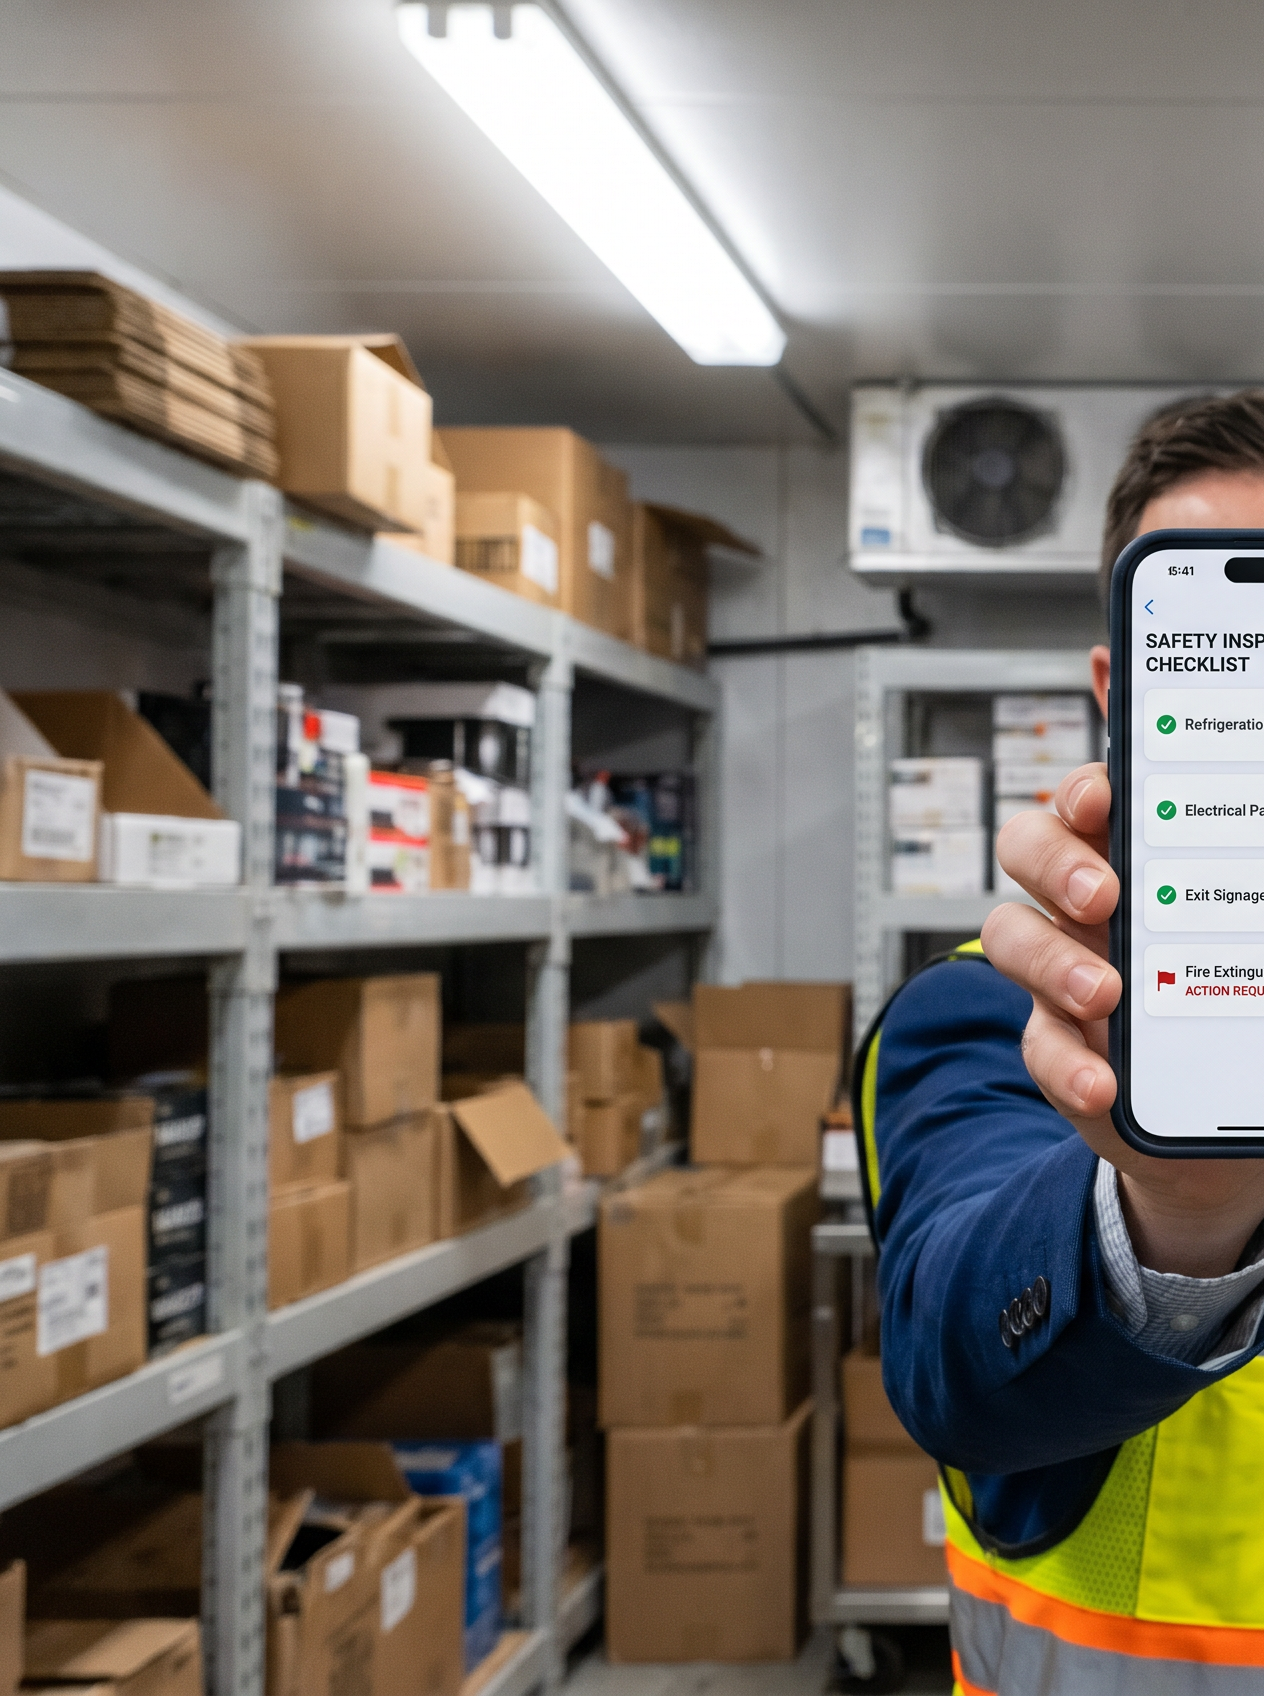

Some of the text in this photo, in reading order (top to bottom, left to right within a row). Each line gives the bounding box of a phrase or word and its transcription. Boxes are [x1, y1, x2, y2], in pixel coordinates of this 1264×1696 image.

[1167, 565, 1194, 576] 15:41
[1145, 632, 1218, 649] SAFETY
[1145, 656, 1251, 673] CHECKLIST
[1185, 803, 1246, 817] Electrical
[1185, 888, 1211, 902] Exit
[1185, 965, 1211, 978] Fire
[1185, 985, 1230, 996] ACTION
